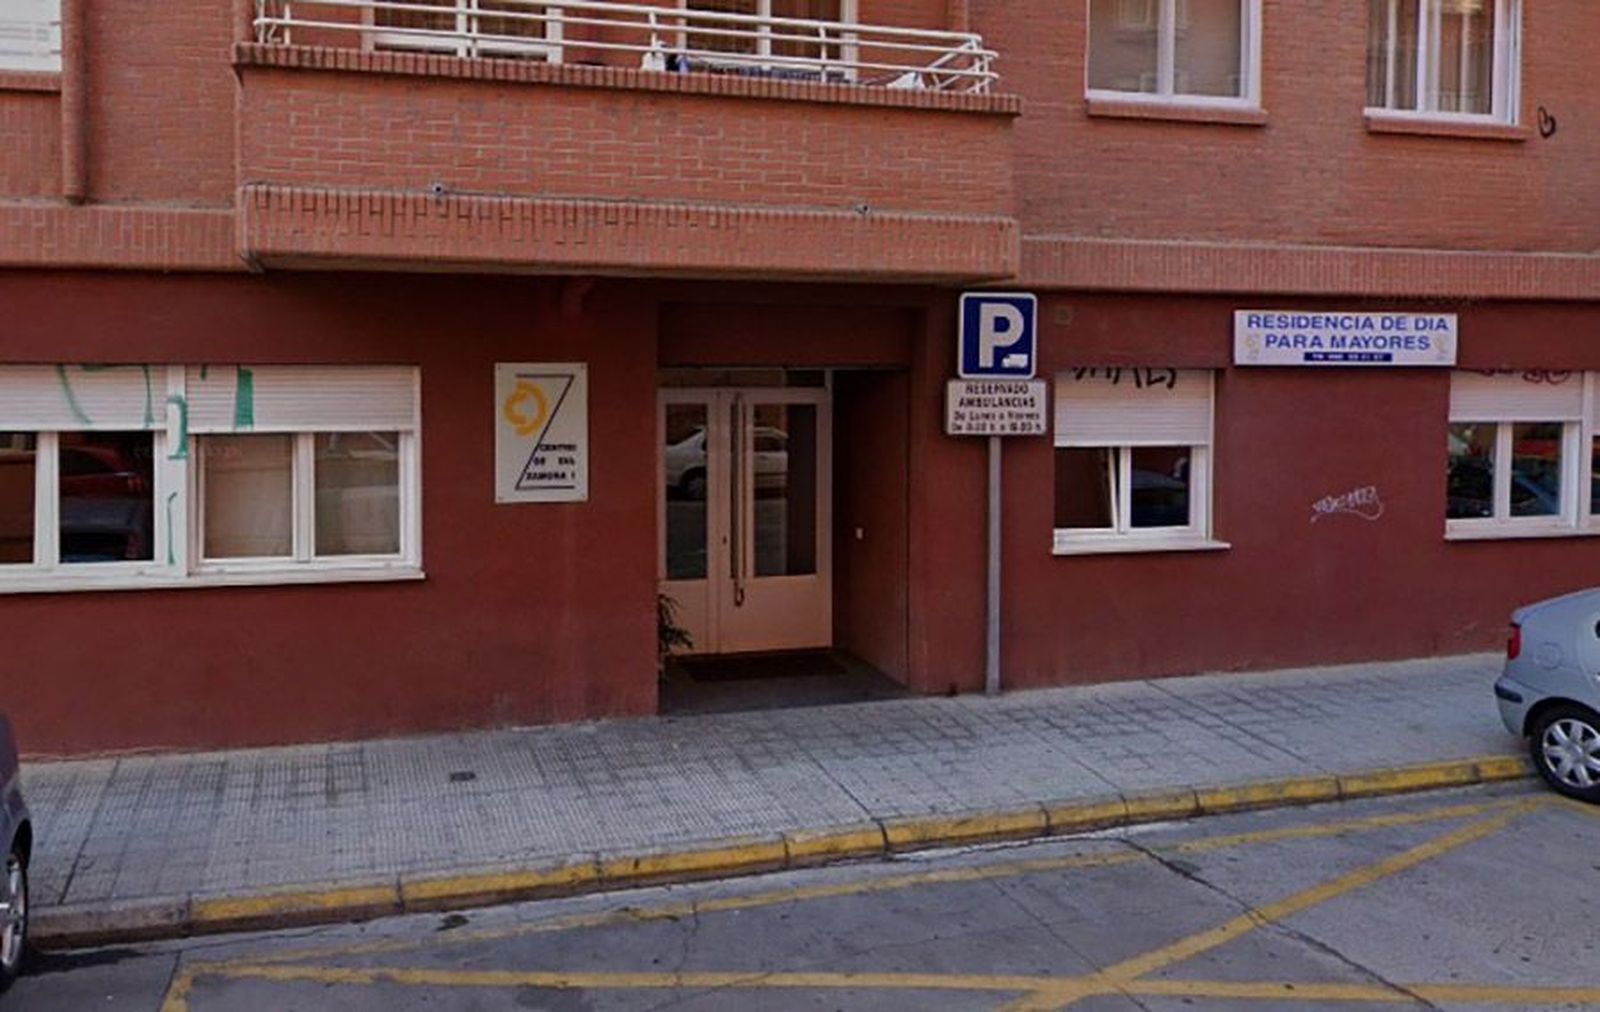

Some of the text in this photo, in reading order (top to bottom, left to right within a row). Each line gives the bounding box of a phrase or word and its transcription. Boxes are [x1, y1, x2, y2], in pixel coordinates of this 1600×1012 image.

[1246, 314, 1449, 332] RESIDENCIA DE DIA
[979, 303, 1024, 368] P
[1264, 333, 1432, 350] PARA MAYORES
[965, 384, 1029, 395] RESERVADO
[958, 397, 1036, 408] AMBULANCIAS
